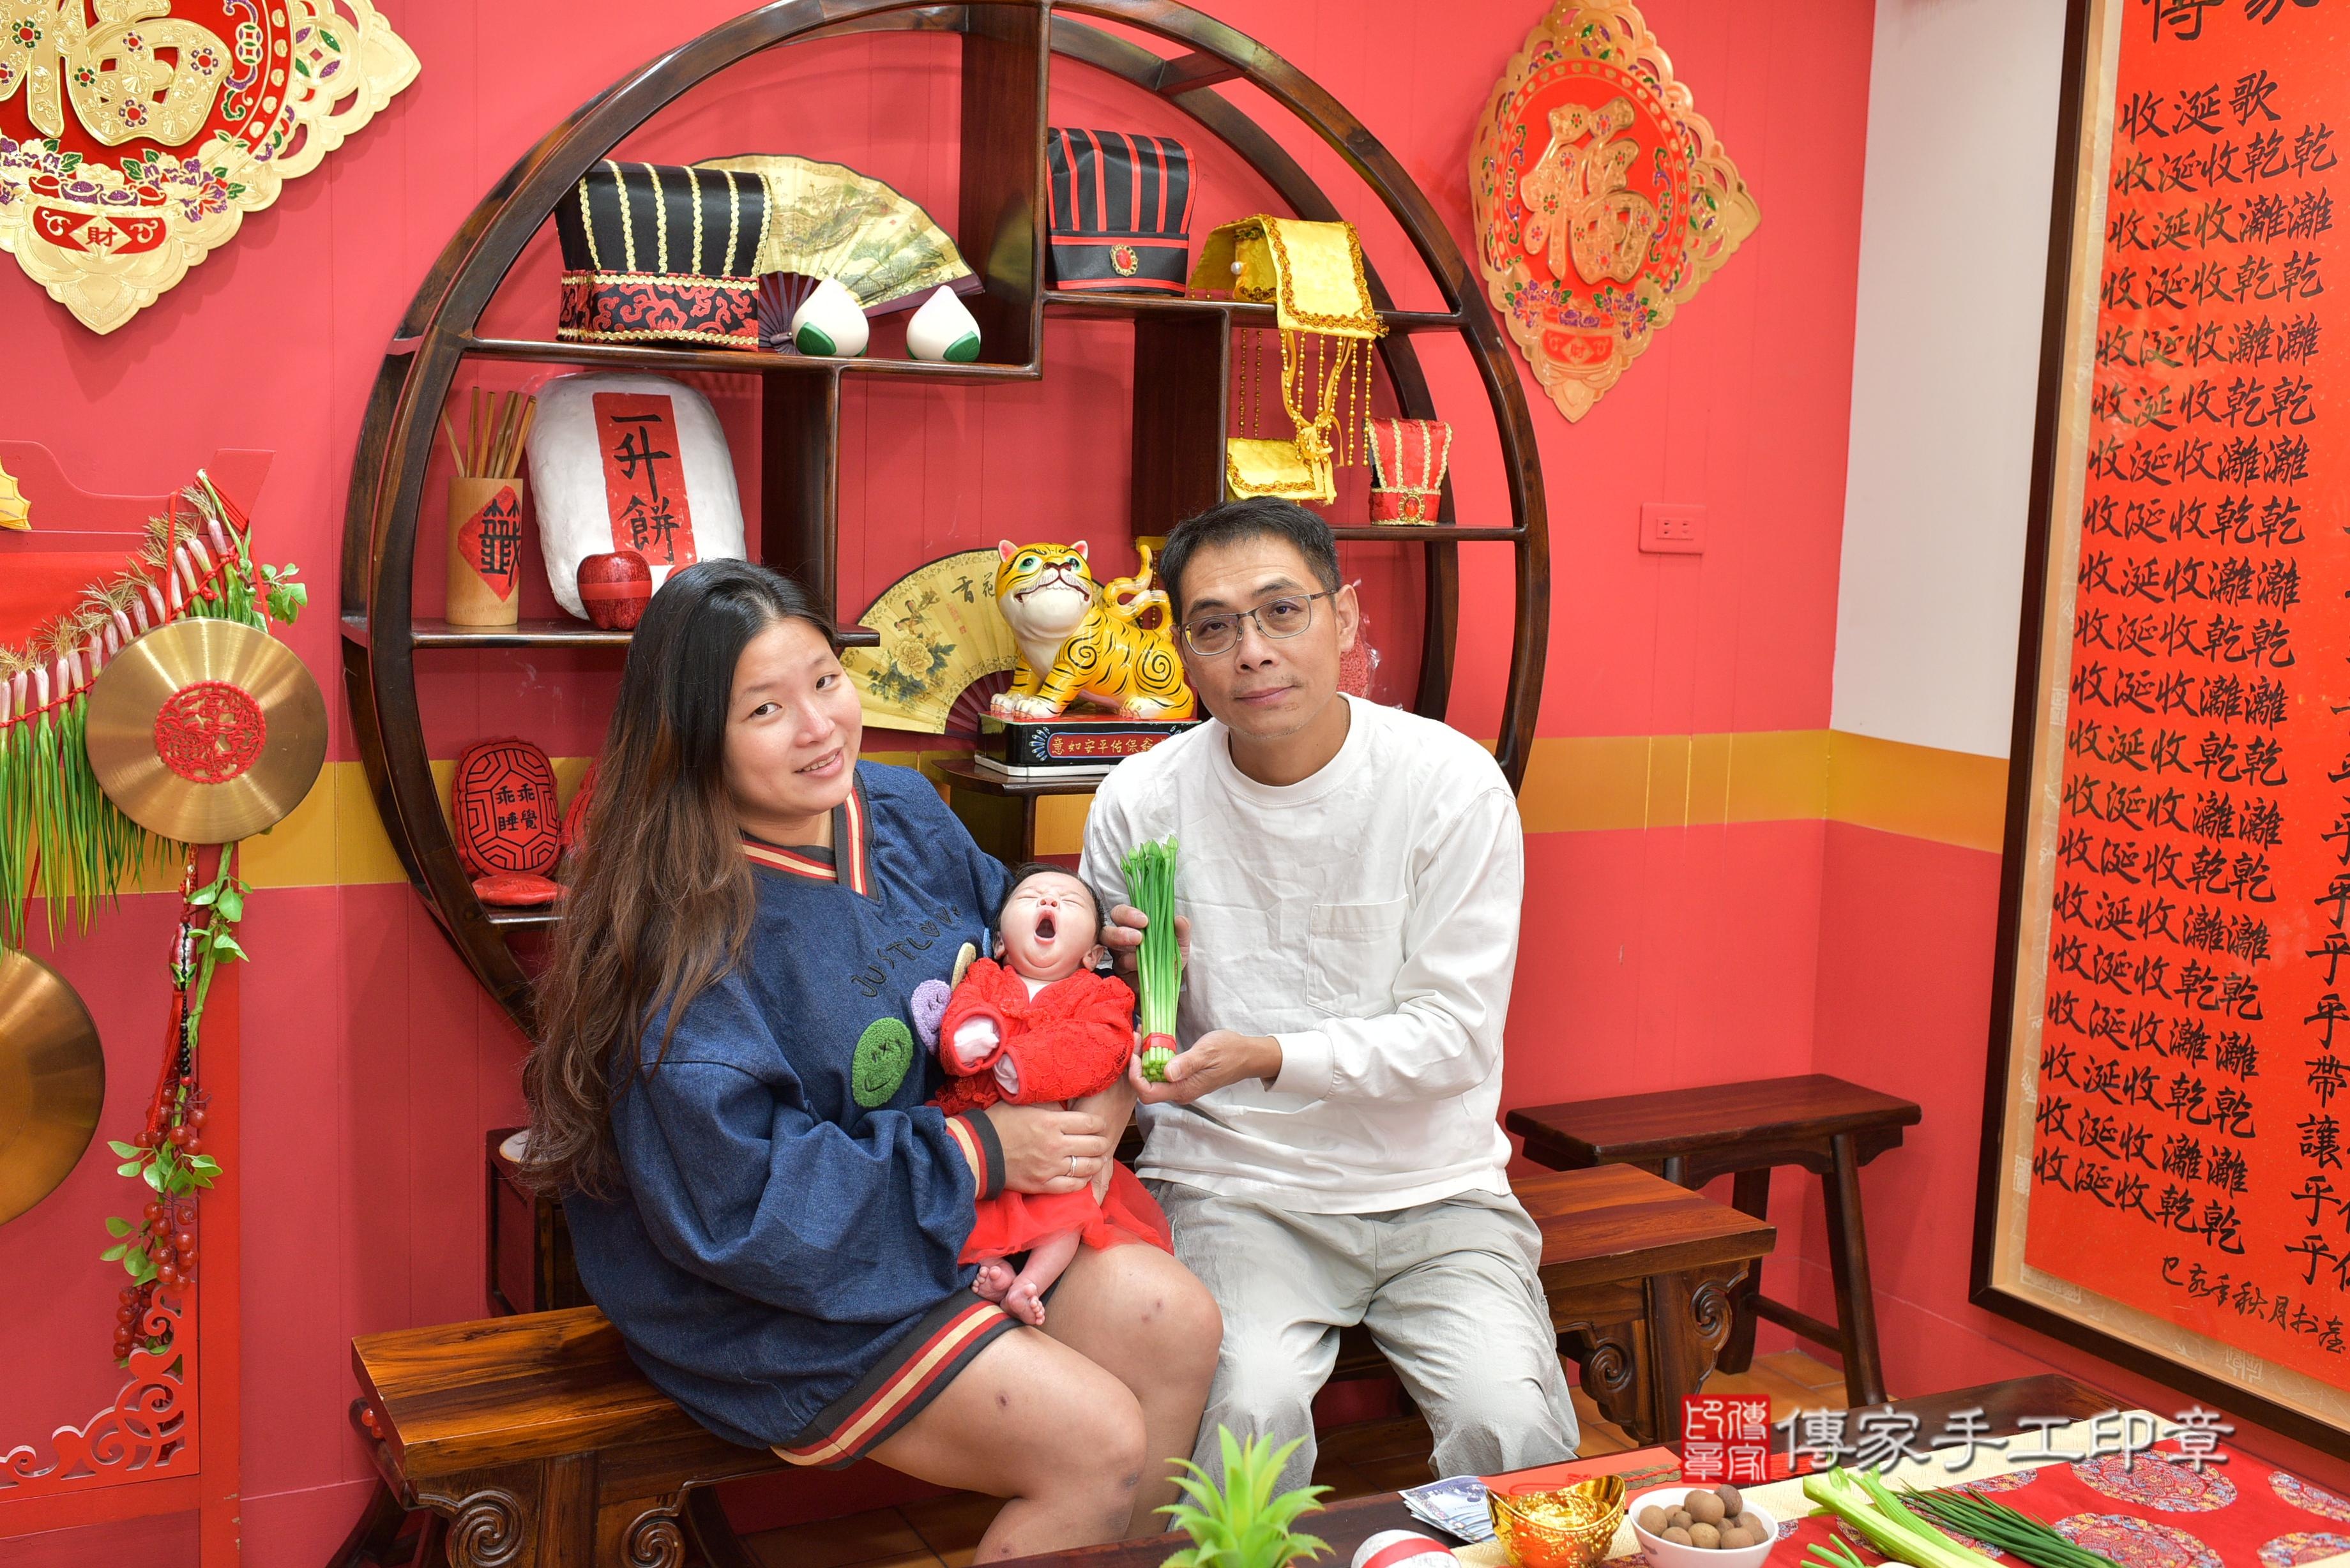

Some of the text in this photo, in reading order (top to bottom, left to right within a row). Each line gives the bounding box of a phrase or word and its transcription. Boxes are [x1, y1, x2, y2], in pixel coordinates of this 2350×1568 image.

[2119, 70, 2282, 145] 收涎歌
[2114, 121, 2337, 196] 收涎收乾乾
[1520, 96, 1658, 285] 福
[87, 227, 117, 246] 財
[2101, 251, 2325, 310] 收涎收乾乾
[1570, 344, 1586, 358] 財
[2092, 375, 2317, 432] 收涎收乾乾
[610, 413, 680, 564] 一升餅
[2083, 495, 2306, 547] 收涎收乾乾
[2073, 608, 2295, 668] 收涎收乾乾
[2068, 720, 2288, 786] 收涎收乾乾
[496, 783, 535, 805] 乖乖
[498, 809, 537, 831] 睡覺
[2058, 828, 2276, 902] 收涎收乾乾
[851, 942, 916, 997] JUST
[2053, 933, 2264, 1020] 收涎收乾乾
[2040, 1043, 2255, 1138] 收涎收乾乾
[2033, 1147, 2245, 1254] 收涎收乾乾
